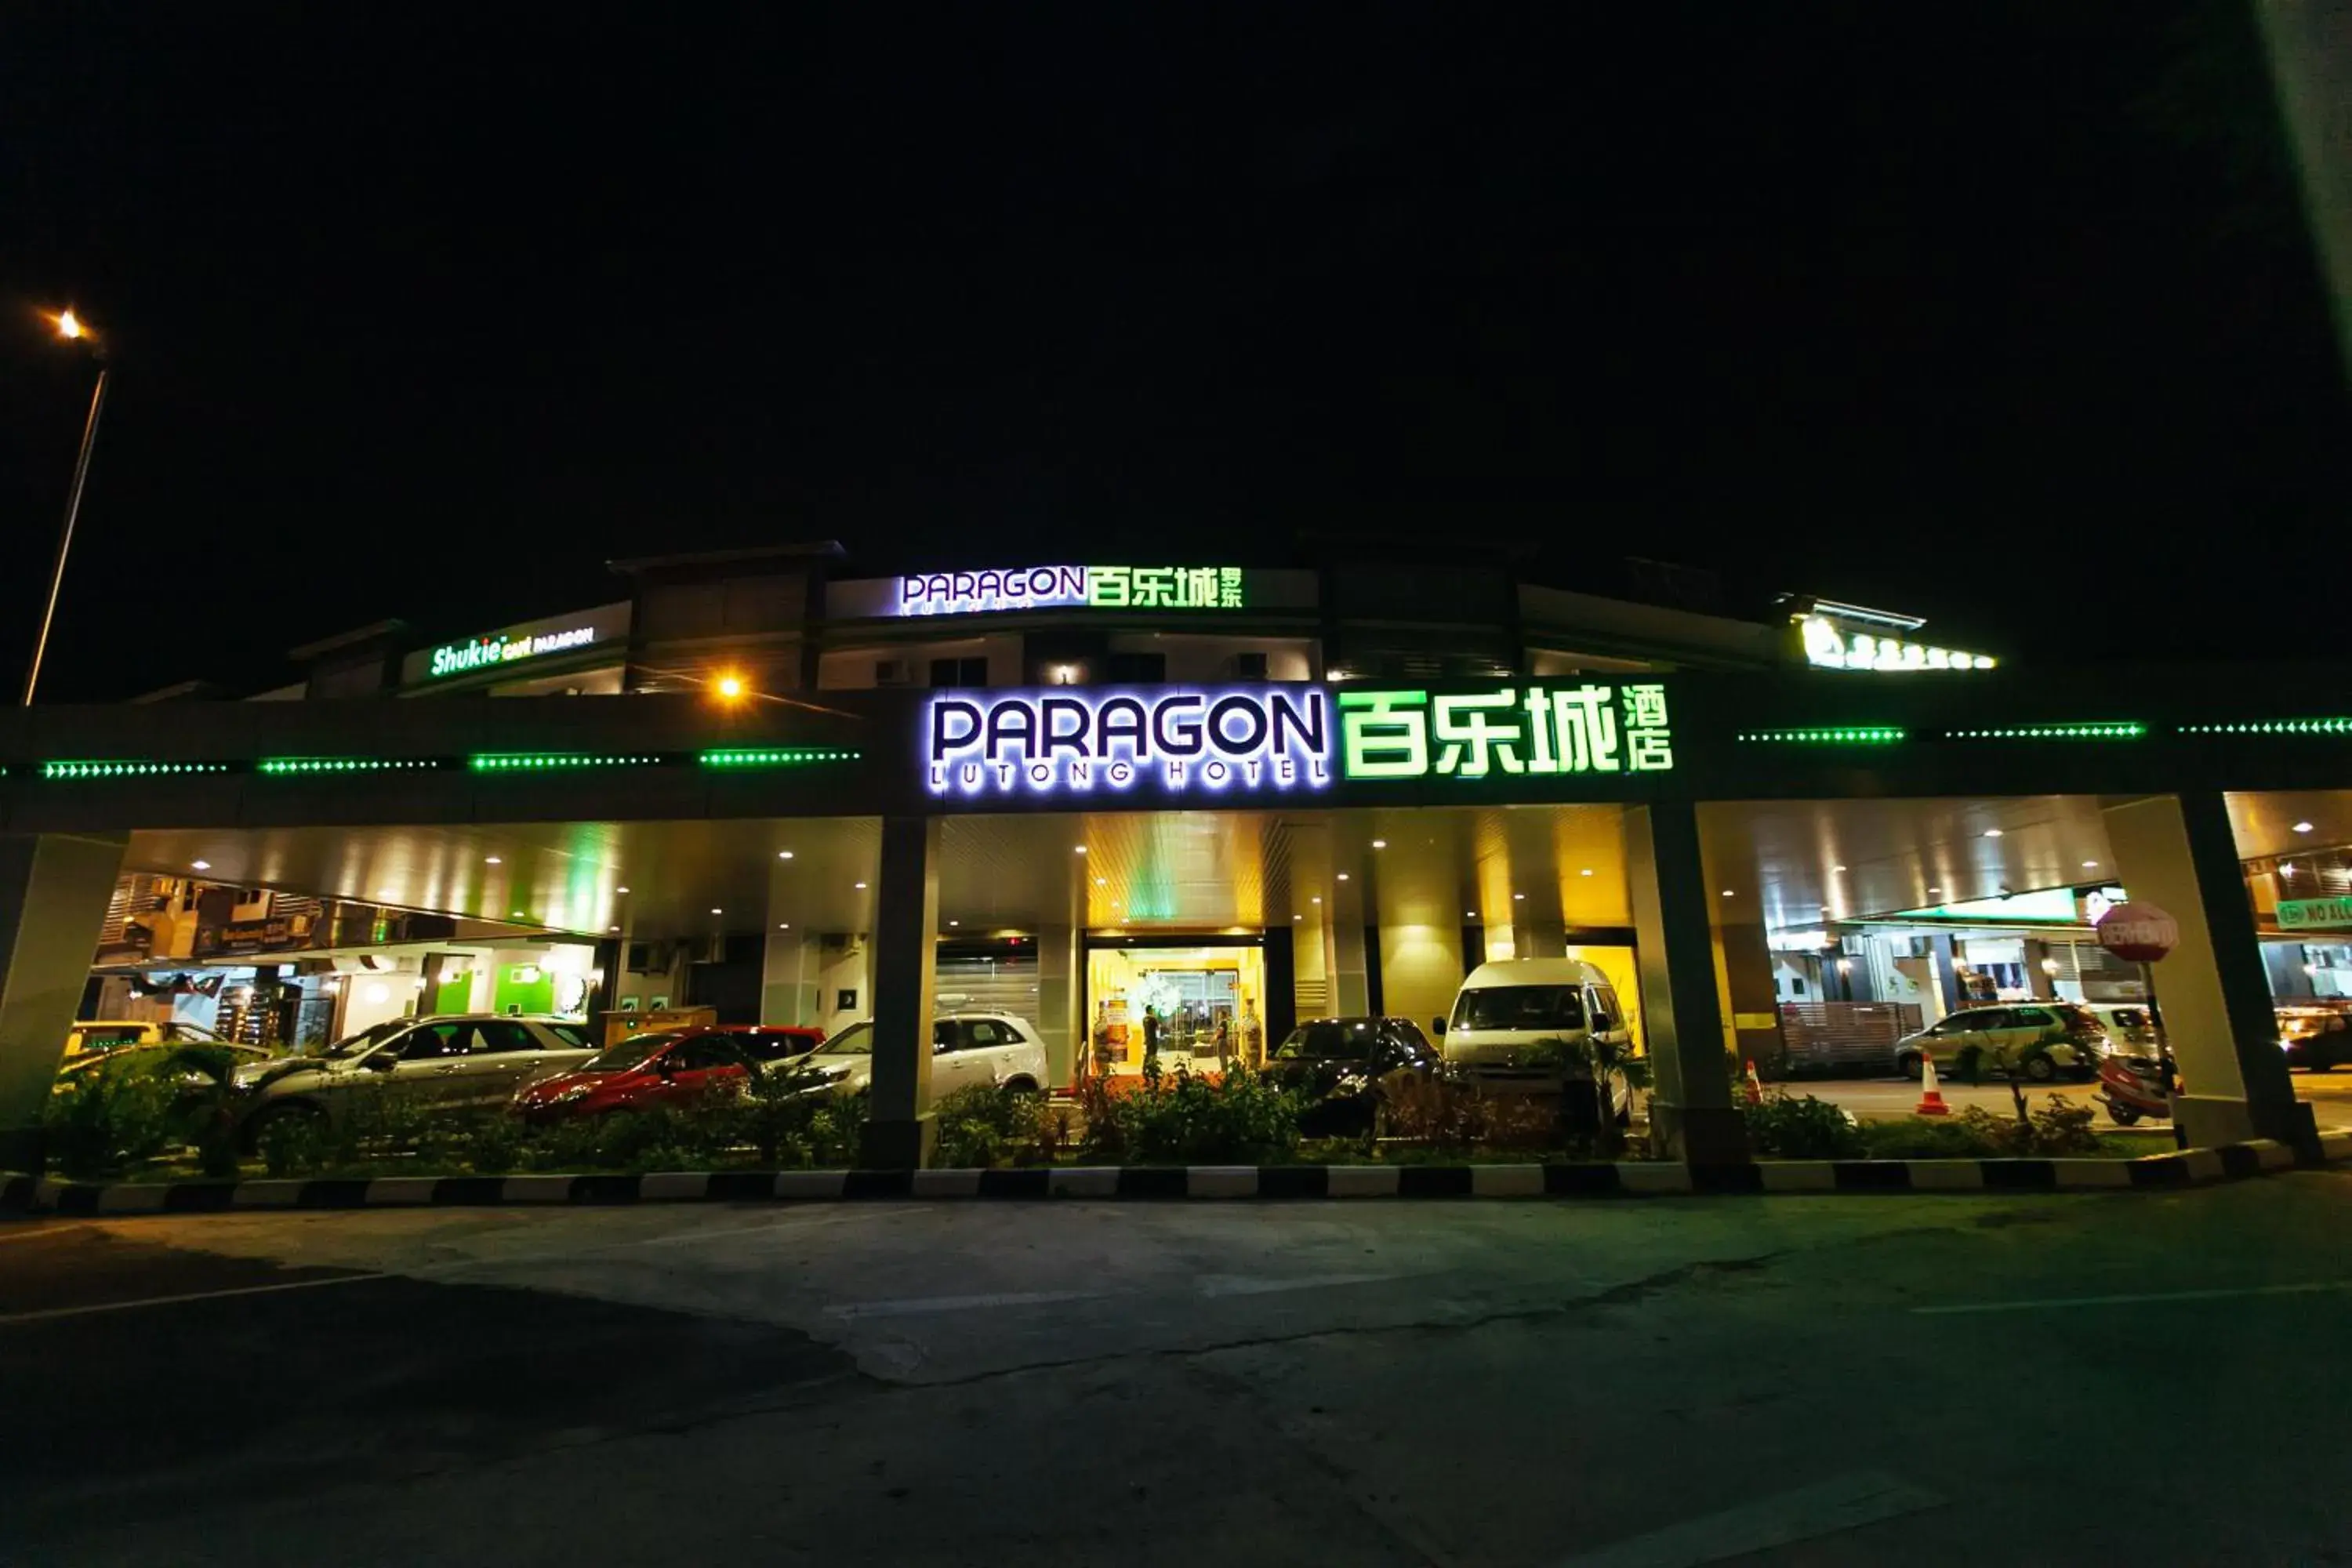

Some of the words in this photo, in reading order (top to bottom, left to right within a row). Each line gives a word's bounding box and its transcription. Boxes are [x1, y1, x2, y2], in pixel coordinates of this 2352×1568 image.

[902, 566, 1085, 604] PARAGON
[1088, 566, 1218, 608] 百乐城
[432, 637, 502, 676] Shukie
[931, 693, 1325, 761] PARAGON
[1338, 684, 1621, 778] 百乐城
[1621, 684, 1675, 772] 酒店
[931, 761, 1130, 786] LUTONG
[1170, 759, 1326, 781] HOTEL
